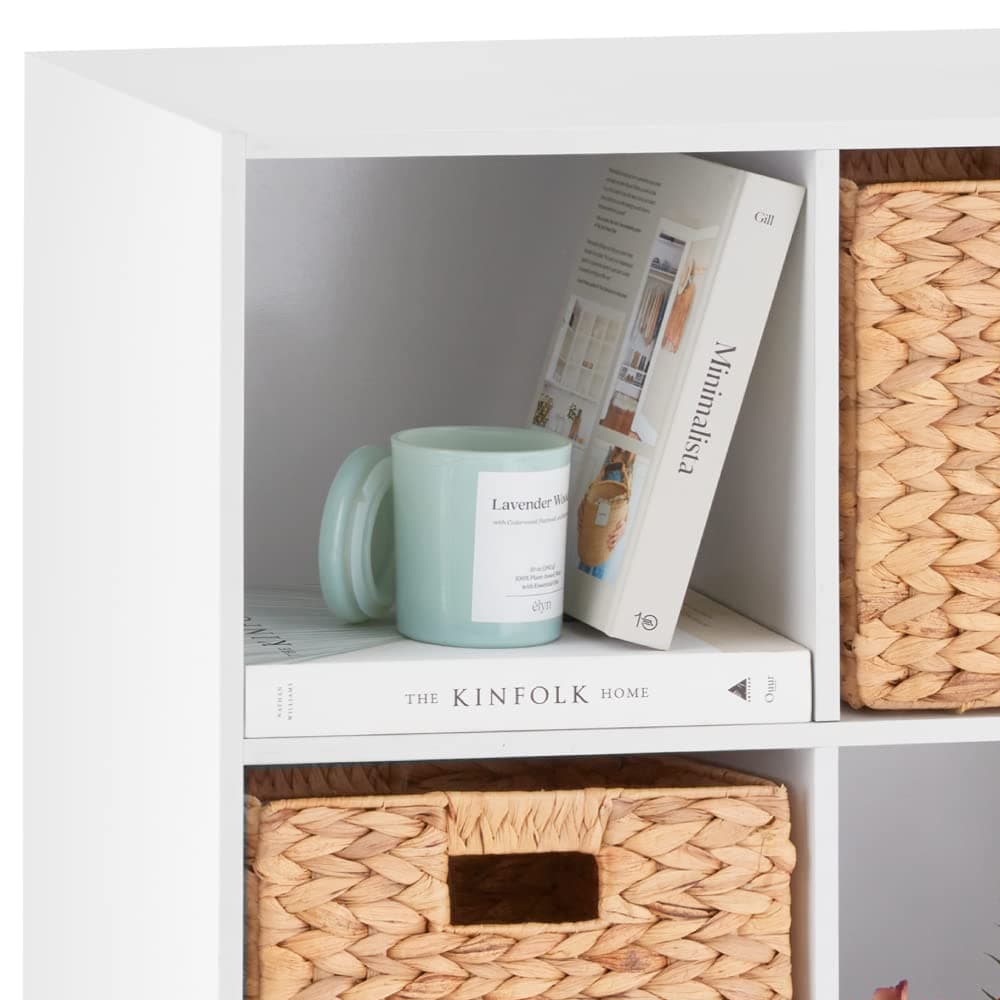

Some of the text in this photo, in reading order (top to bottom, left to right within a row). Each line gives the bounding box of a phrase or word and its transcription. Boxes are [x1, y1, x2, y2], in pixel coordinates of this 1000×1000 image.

[754, 211, 775, 226] Gill
[678, 341, 737, 474] Minimalista
[492, 497, 552, 511] Lavender
[404, 685, 650, 707] THE KINFOLK HOME
